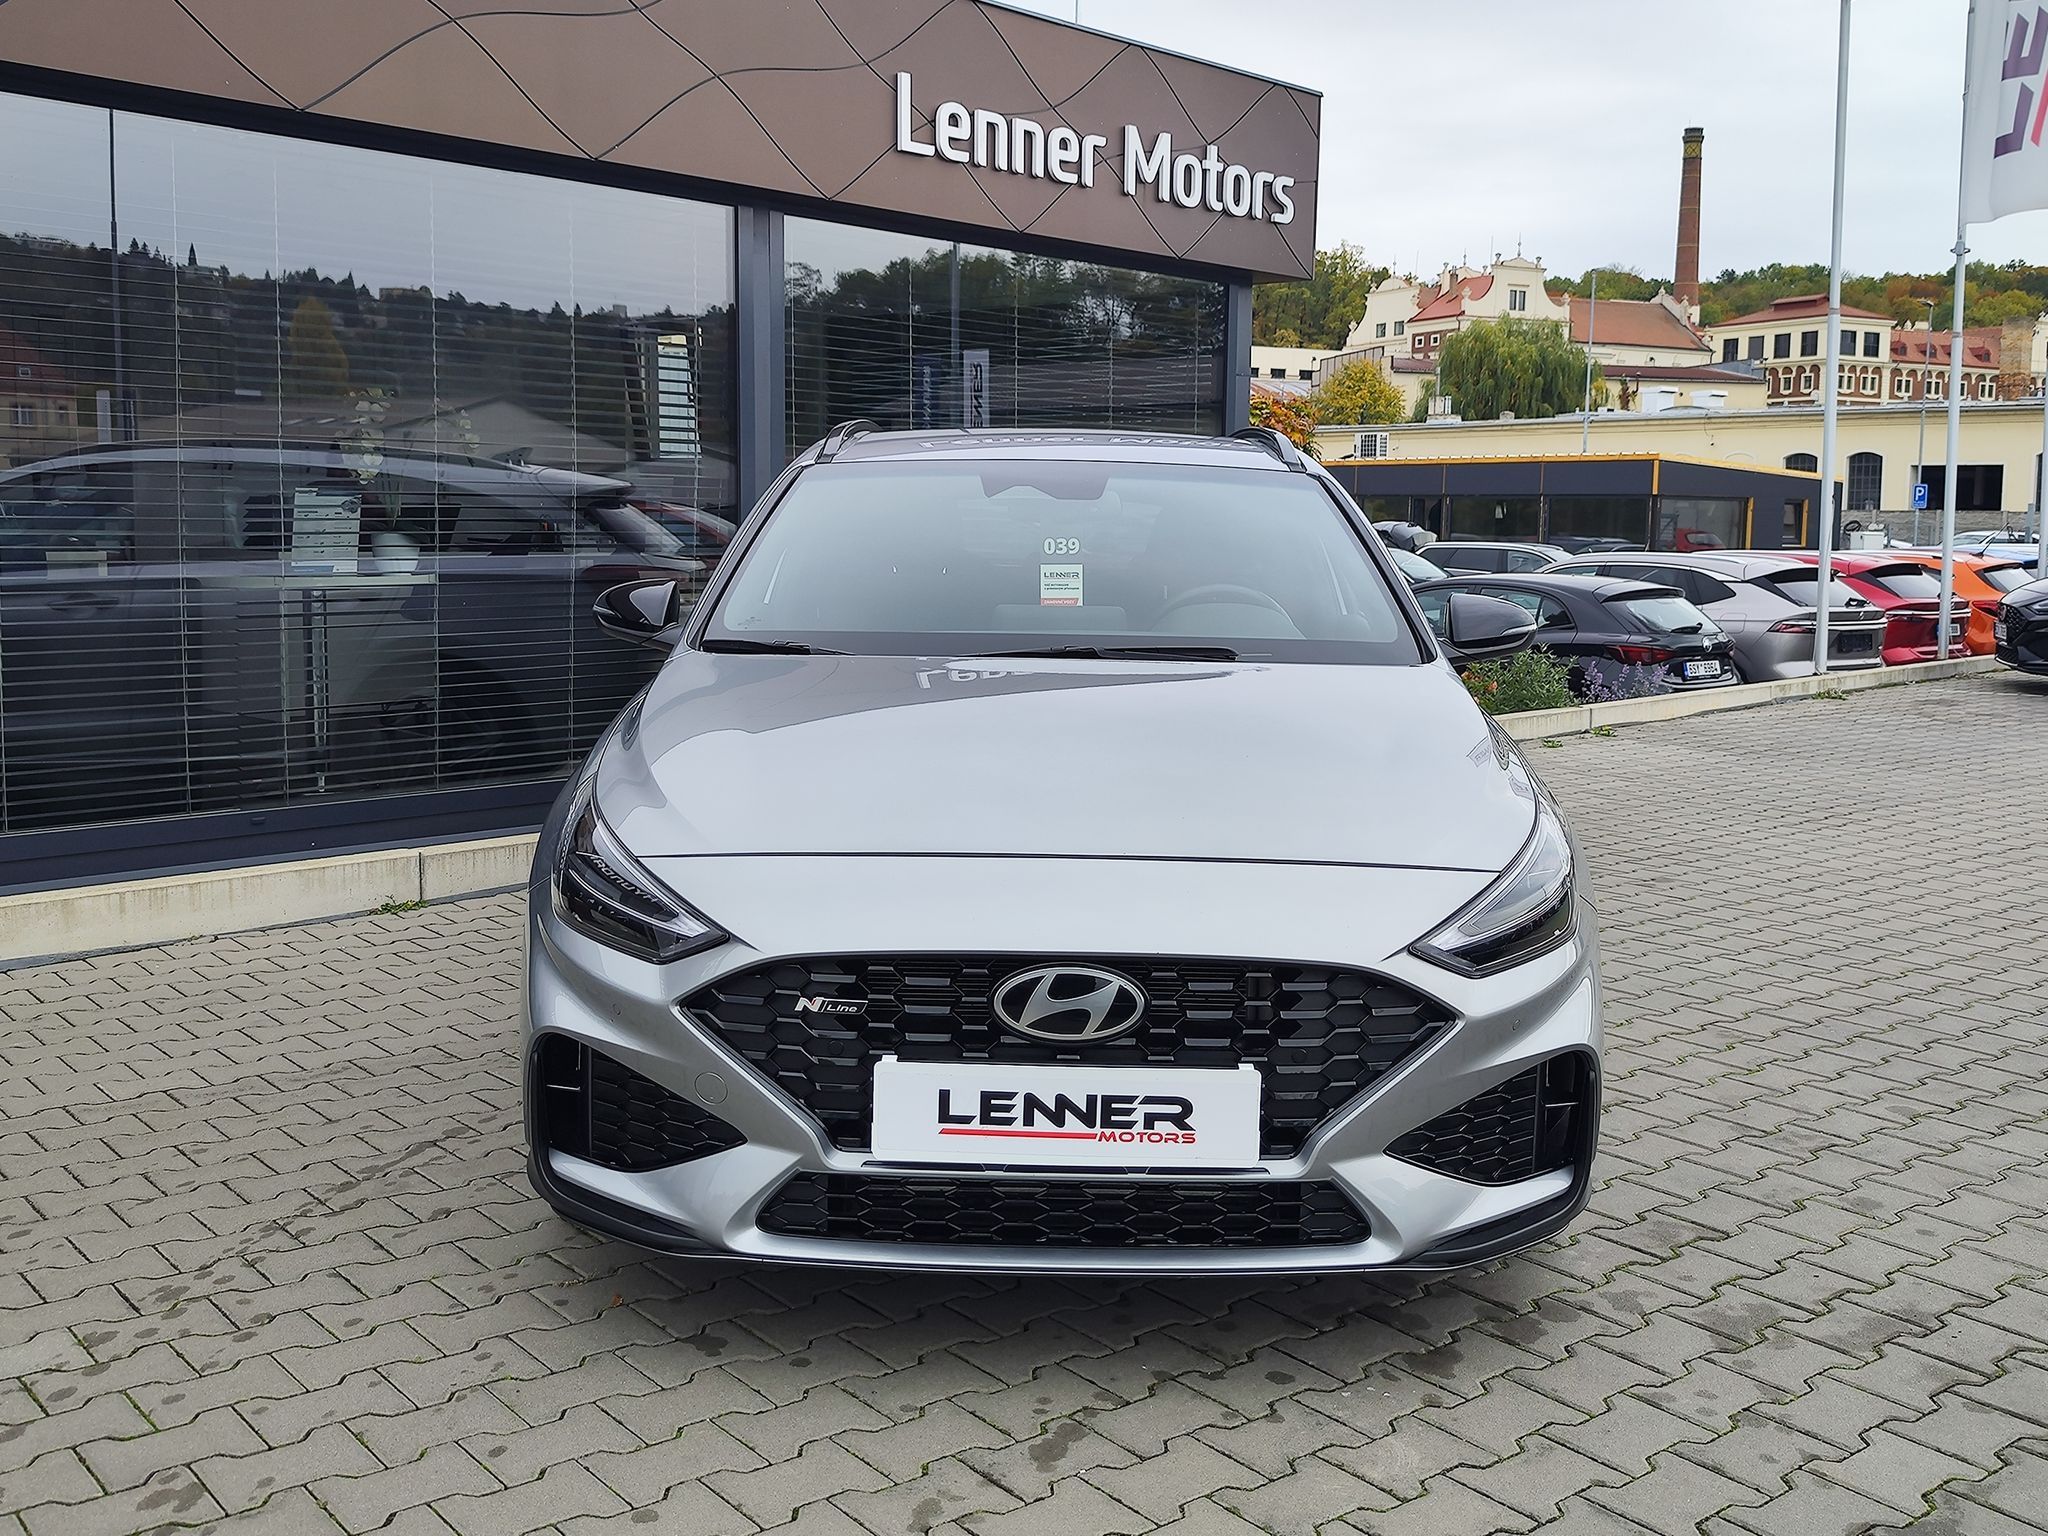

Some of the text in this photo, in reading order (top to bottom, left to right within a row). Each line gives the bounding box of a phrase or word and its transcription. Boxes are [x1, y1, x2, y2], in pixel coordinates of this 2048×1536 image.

[896, 71, 1296, 225] Lenner Motors
[1915, 487, 1925, 501] P
[1043, 537, 1080, 555] 039
[827, 1004, 858, 1013] Line
[938, 1088, 1196, 1131] LENNER
[1097, 1130, 1196, 1144] MOTORS
